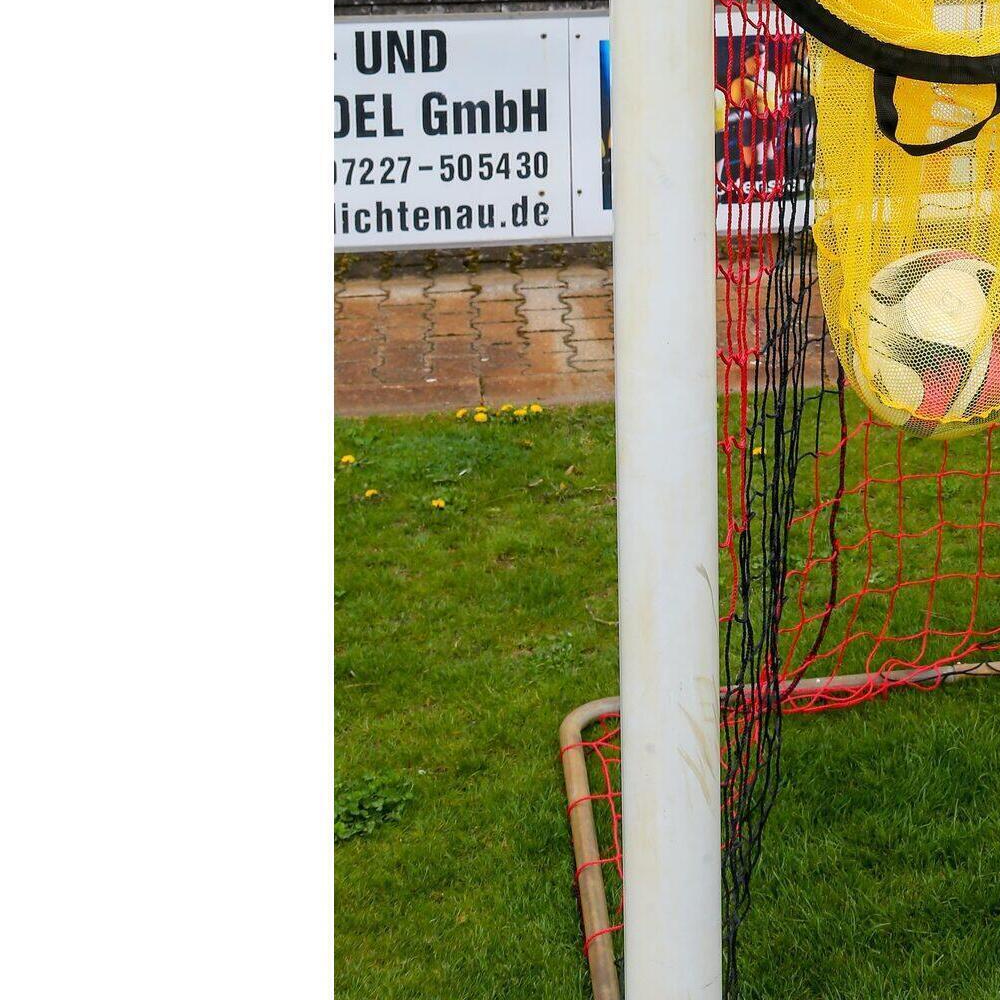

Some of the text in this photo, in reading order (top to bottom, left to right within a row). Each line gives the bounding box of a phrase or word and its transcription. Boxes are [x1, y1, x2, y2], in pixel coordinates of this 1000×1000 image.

[355, 29, 448, 75] UND
[334, 88, 548, 139] DEL GmbH
[334, 151, 549, 186] 7227-505430
[334, 196, 549, 235] ichtenau.de
